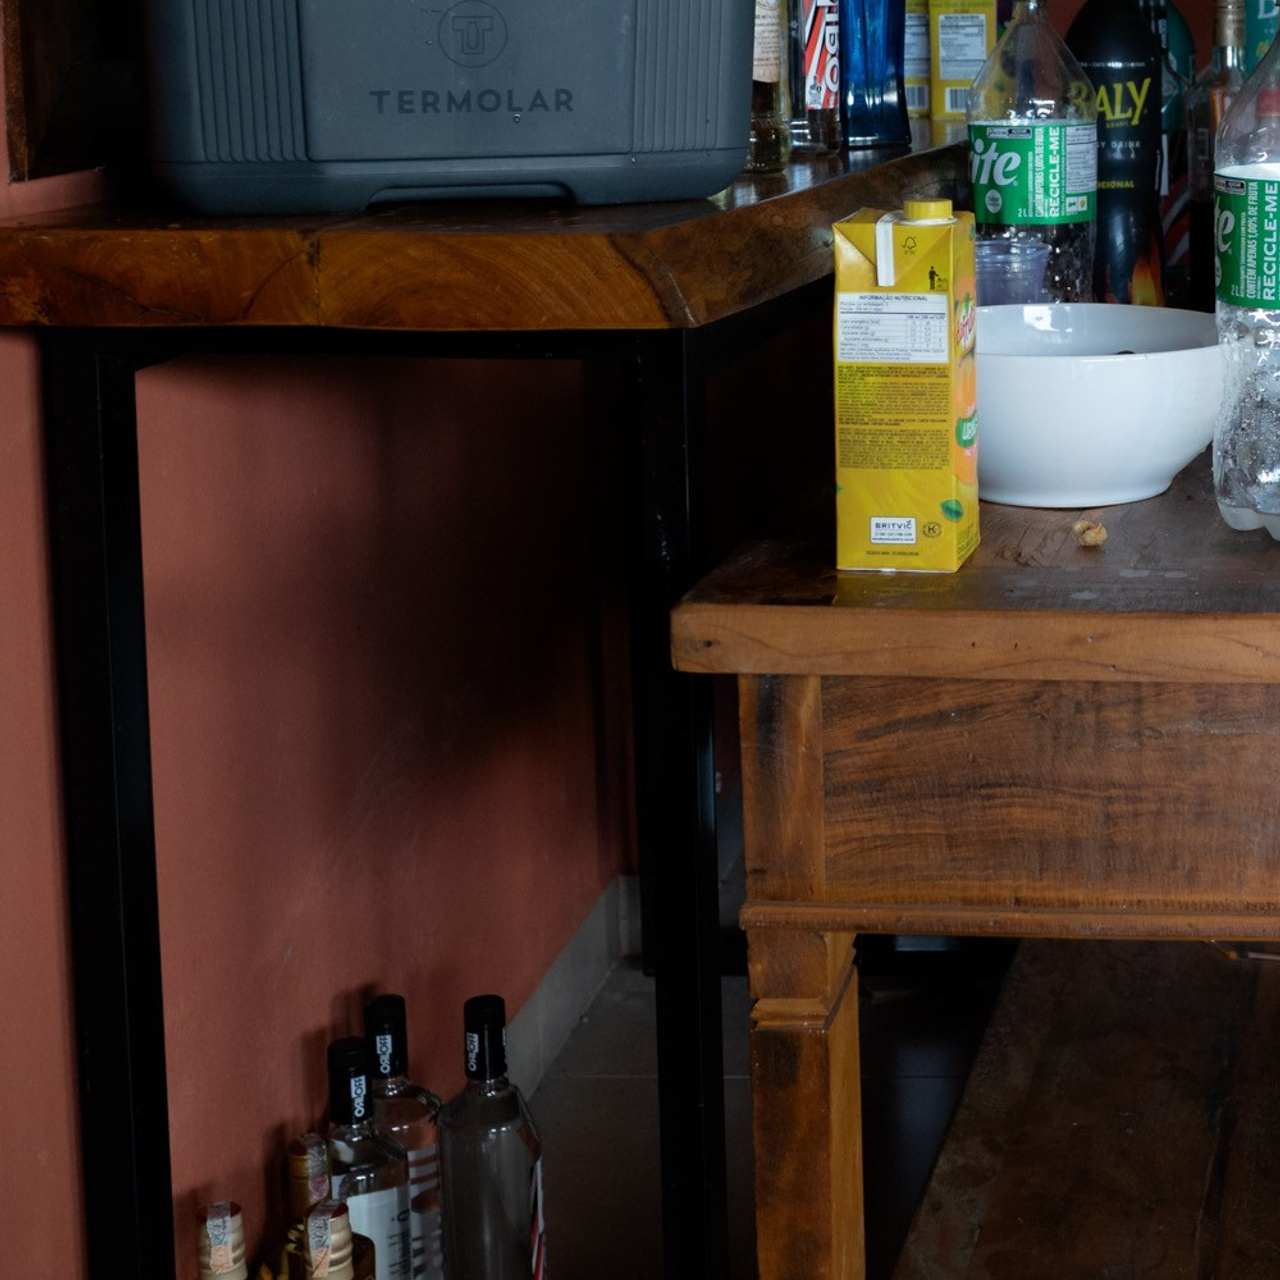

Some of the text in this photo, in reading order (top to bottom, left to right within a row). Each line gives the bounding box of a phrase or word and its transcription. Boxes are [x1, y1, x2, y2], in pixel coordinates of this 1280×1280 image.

[369, 88, 574, 114] TERMOLAR
[1049, 126, 1060, 217] RECICLE-ME
[1248, 181, 1258, 205] FRUTA
[1248, 205, 1258, 216] DE
[1246, 239, 1258, 269] APENAS
[1262, 182, 1278, 300] RECICLE-ME
[1245, 268, 1257, 299] CONTÉM
[876, 521, 912, 529] BRITVIC
[375, 1034, 392, 1074] ORLOFF
[465, 1032, 480, 1072] ORLOFF
[350, 1075, 367, 1118] ORLOFF
